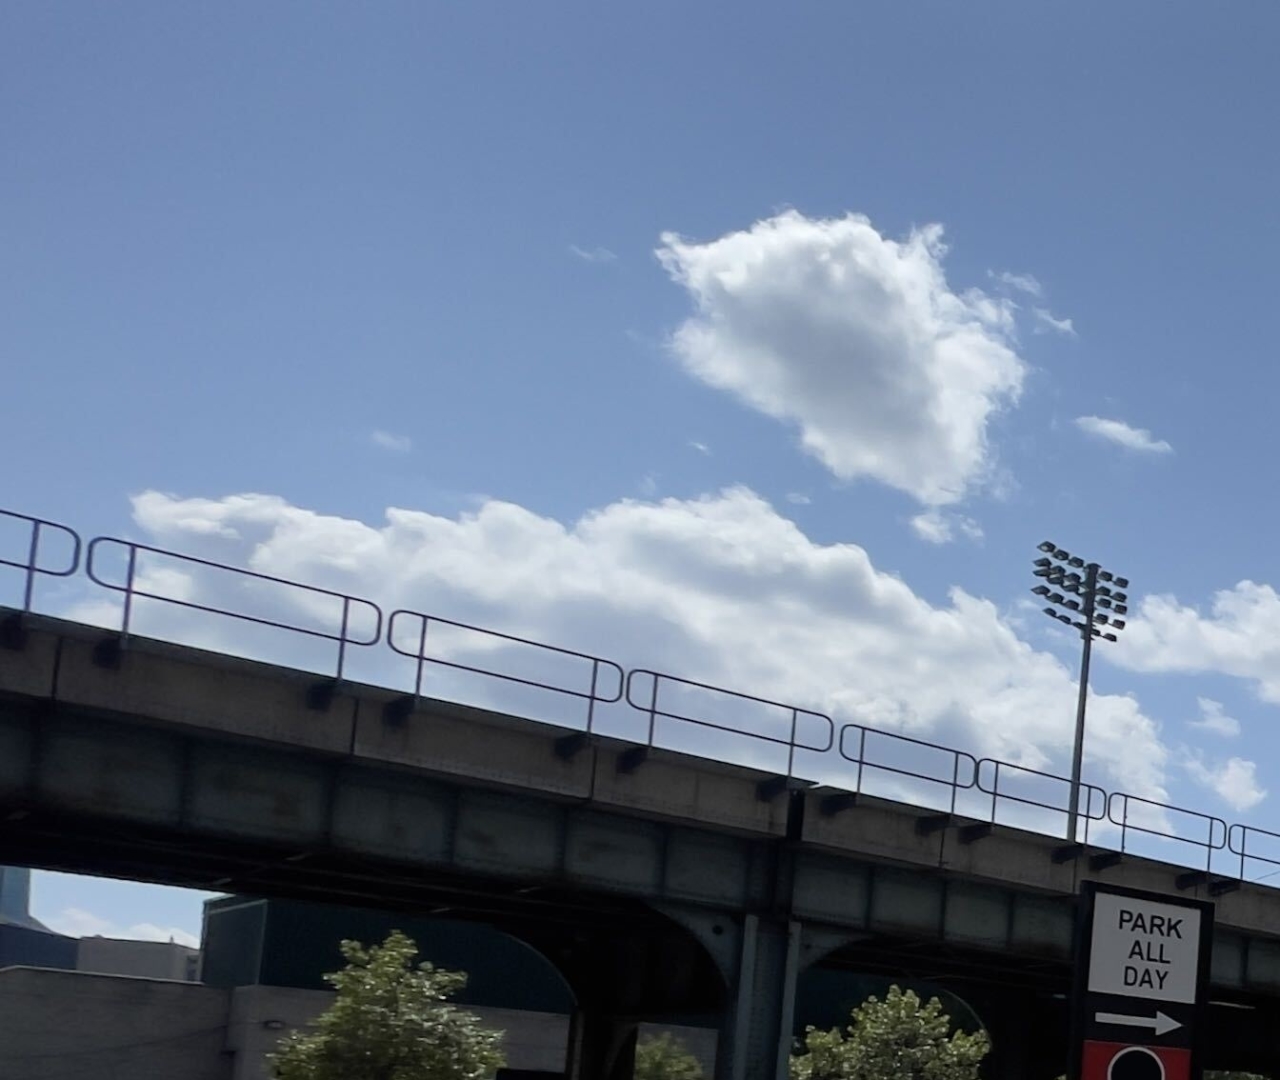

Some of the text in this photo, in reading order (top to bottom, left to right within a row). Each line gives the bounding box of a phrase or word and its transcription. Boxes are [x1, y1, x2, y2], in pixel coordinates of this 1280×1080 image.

[1118, 909, 1183, 939] PARK
[1128, 940, 1171, 964] ALL
[1123, 966, 1169, 990] DAY
